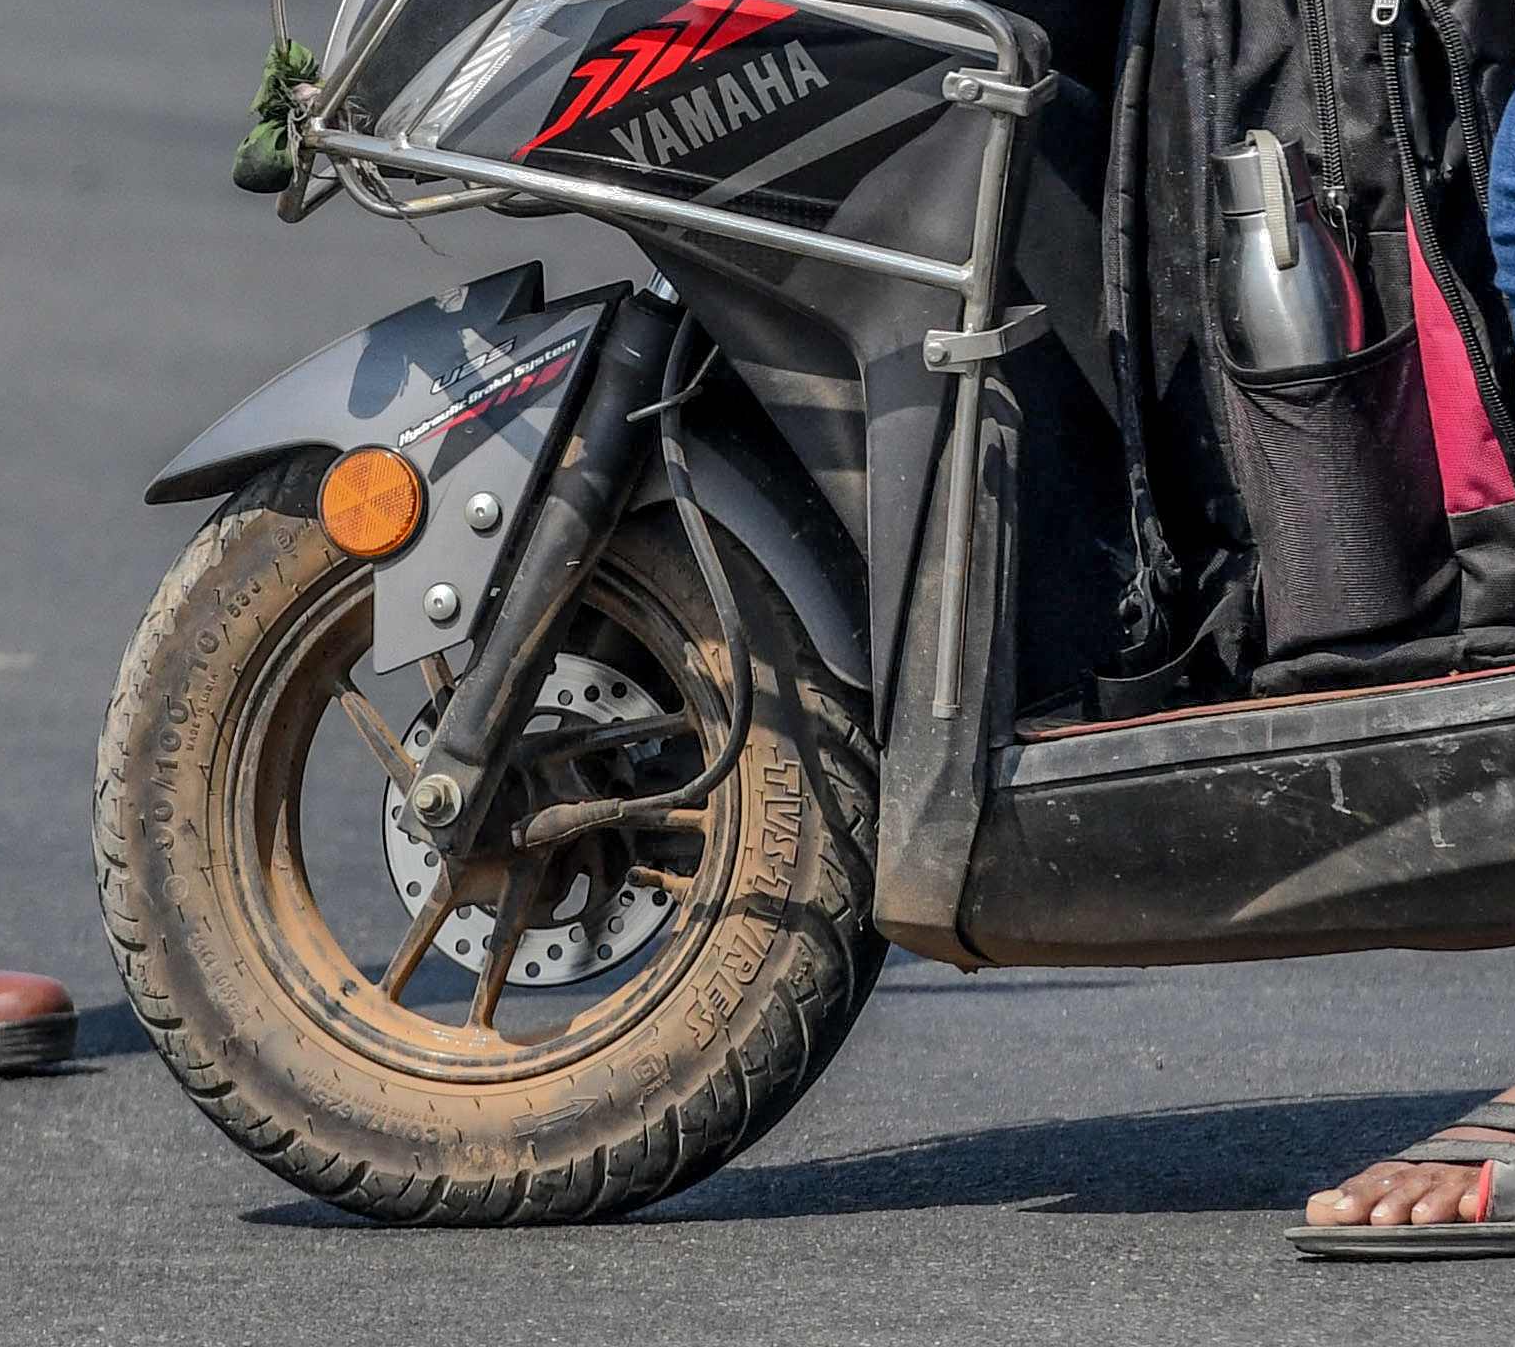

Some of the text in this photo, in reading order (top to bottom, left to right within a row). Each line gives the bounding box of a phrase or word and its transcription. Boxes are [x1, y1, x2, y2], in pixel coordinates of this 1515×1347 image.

[610, 39, 830, 174] YAMAHA
[513, 336, 577, 379] System
[685, 760, 803, 1052] TVS TYRES
